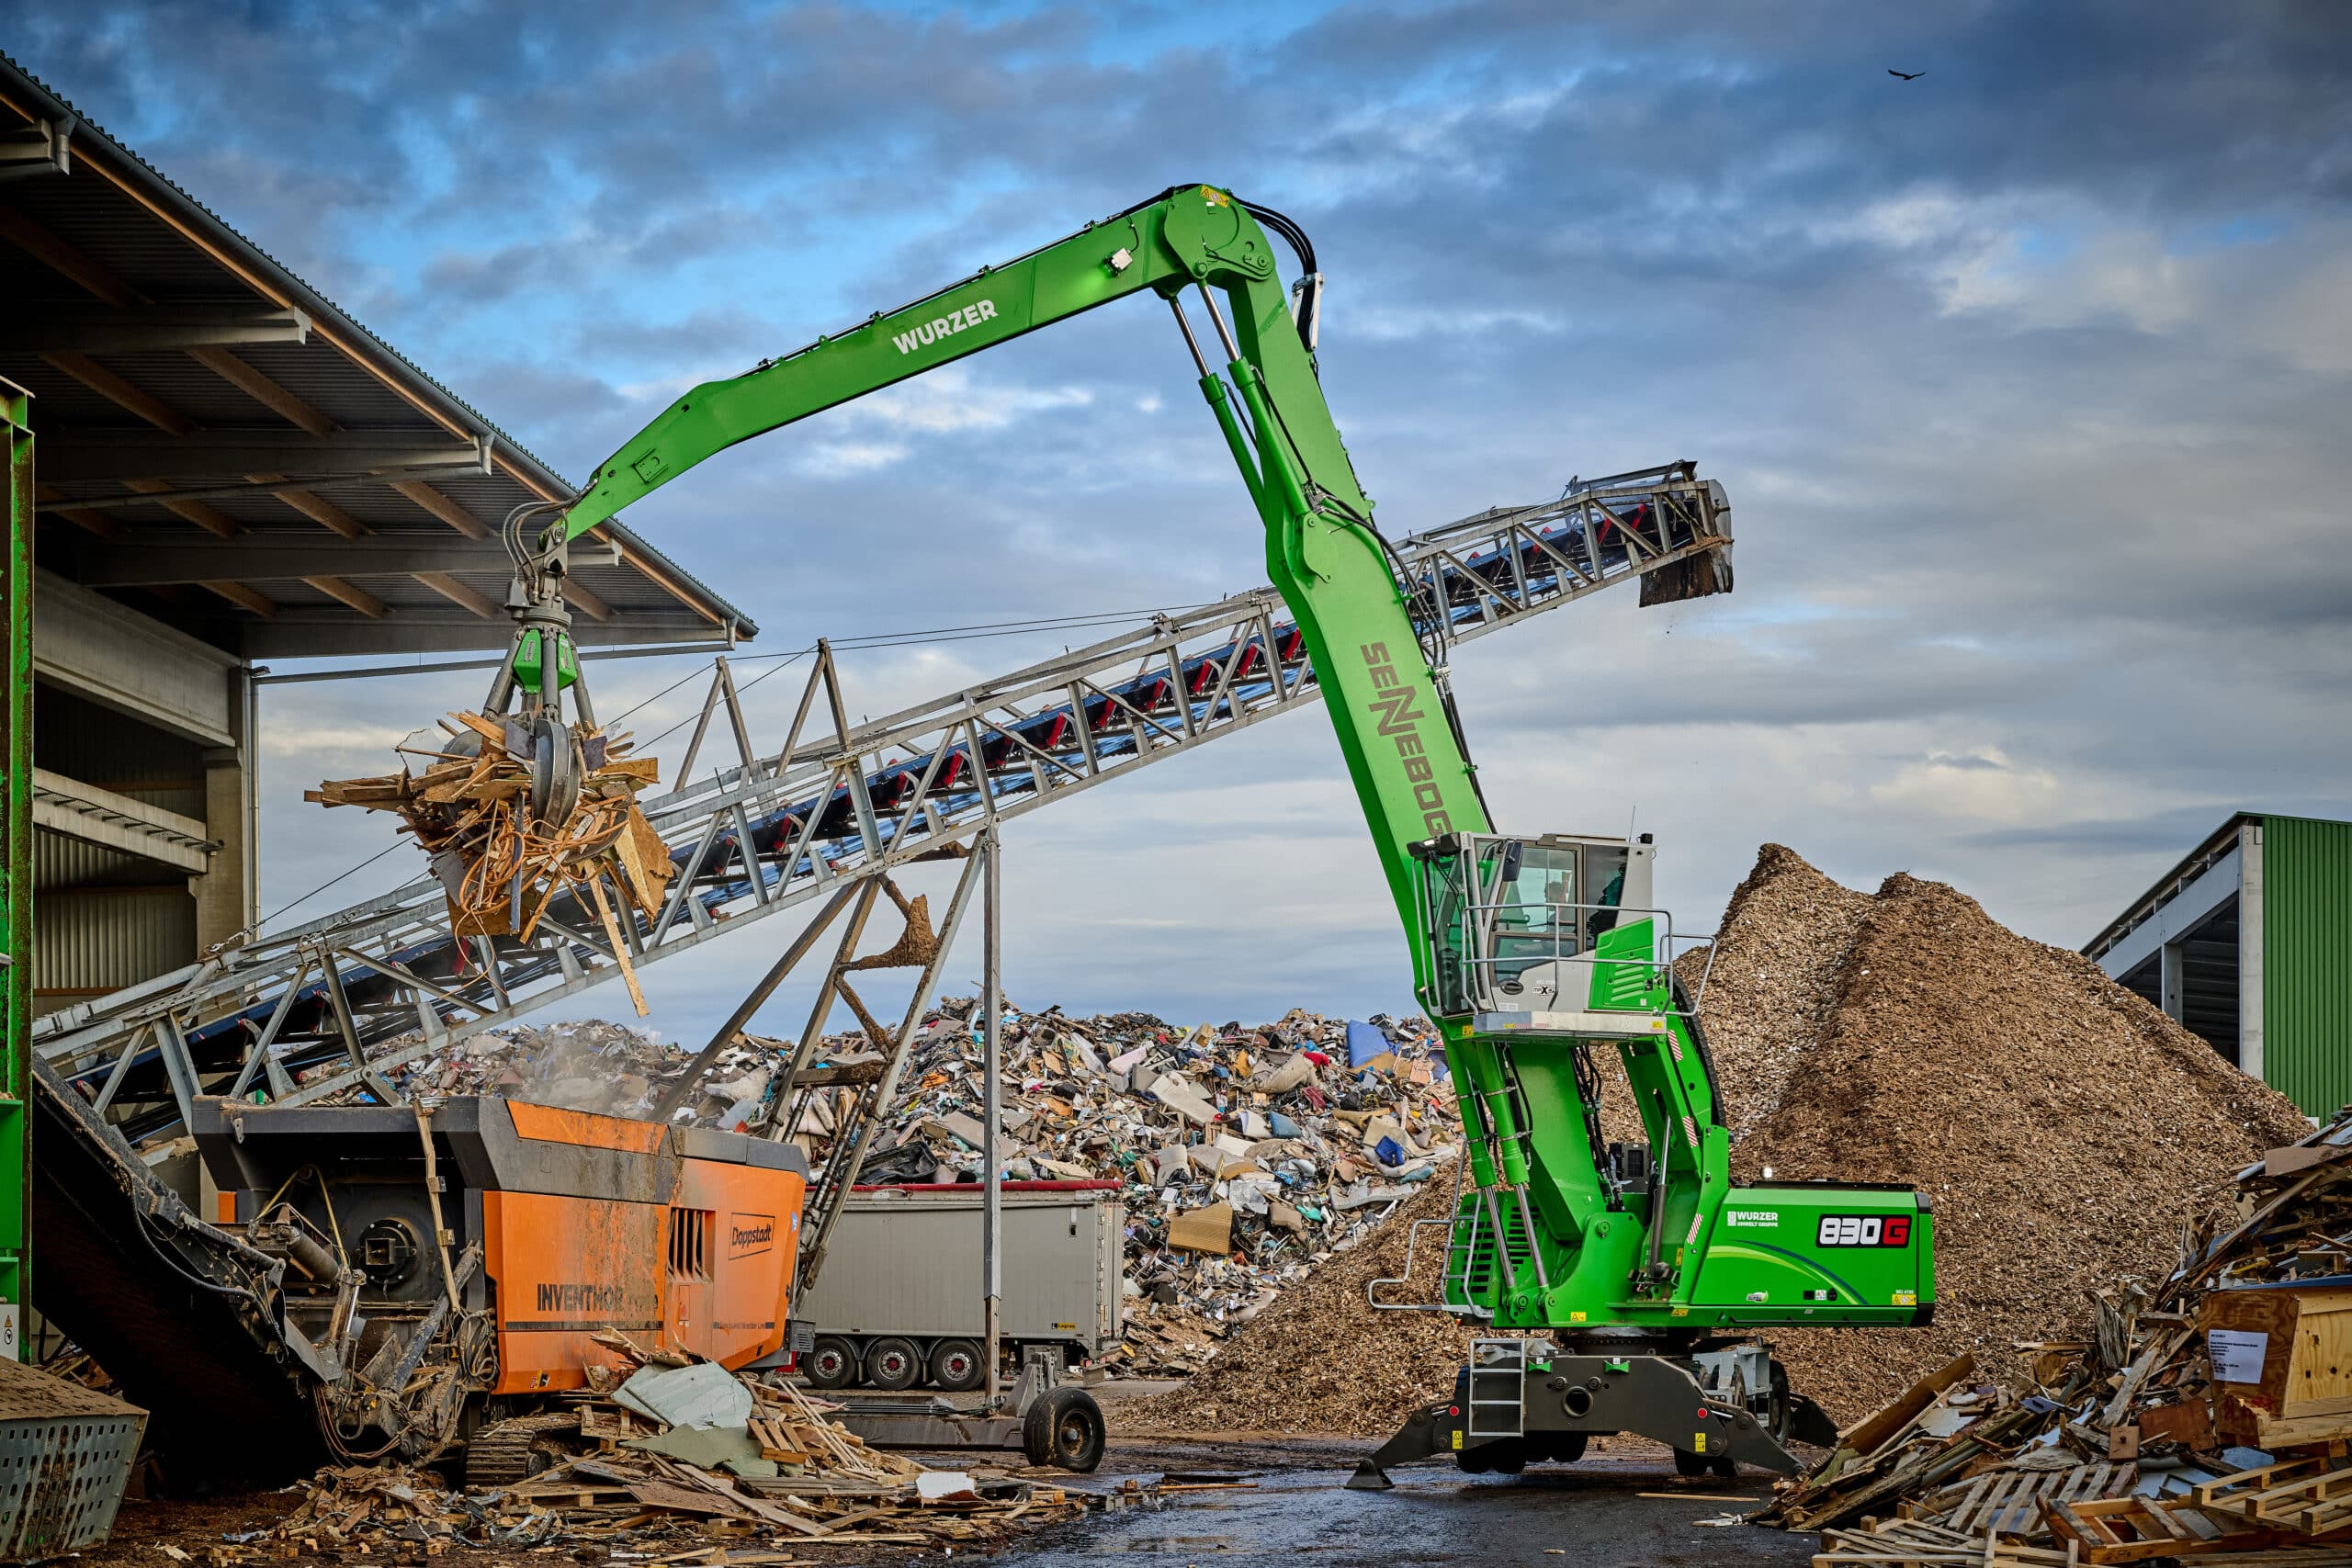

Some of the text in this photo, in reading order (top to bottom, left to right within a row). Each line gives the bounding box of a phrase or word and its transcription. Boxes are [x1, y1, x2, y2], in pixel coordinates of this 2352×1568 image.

[892, 299, 999, 355] WURZER
[1360, 641, 1454, 838] SENNEBOG
[1736, 1212, 1779, 1221] WURZER
[731, 1224, 772, 1249] Doppstadt
[1819, 1217, 1910, 1246] 830G
